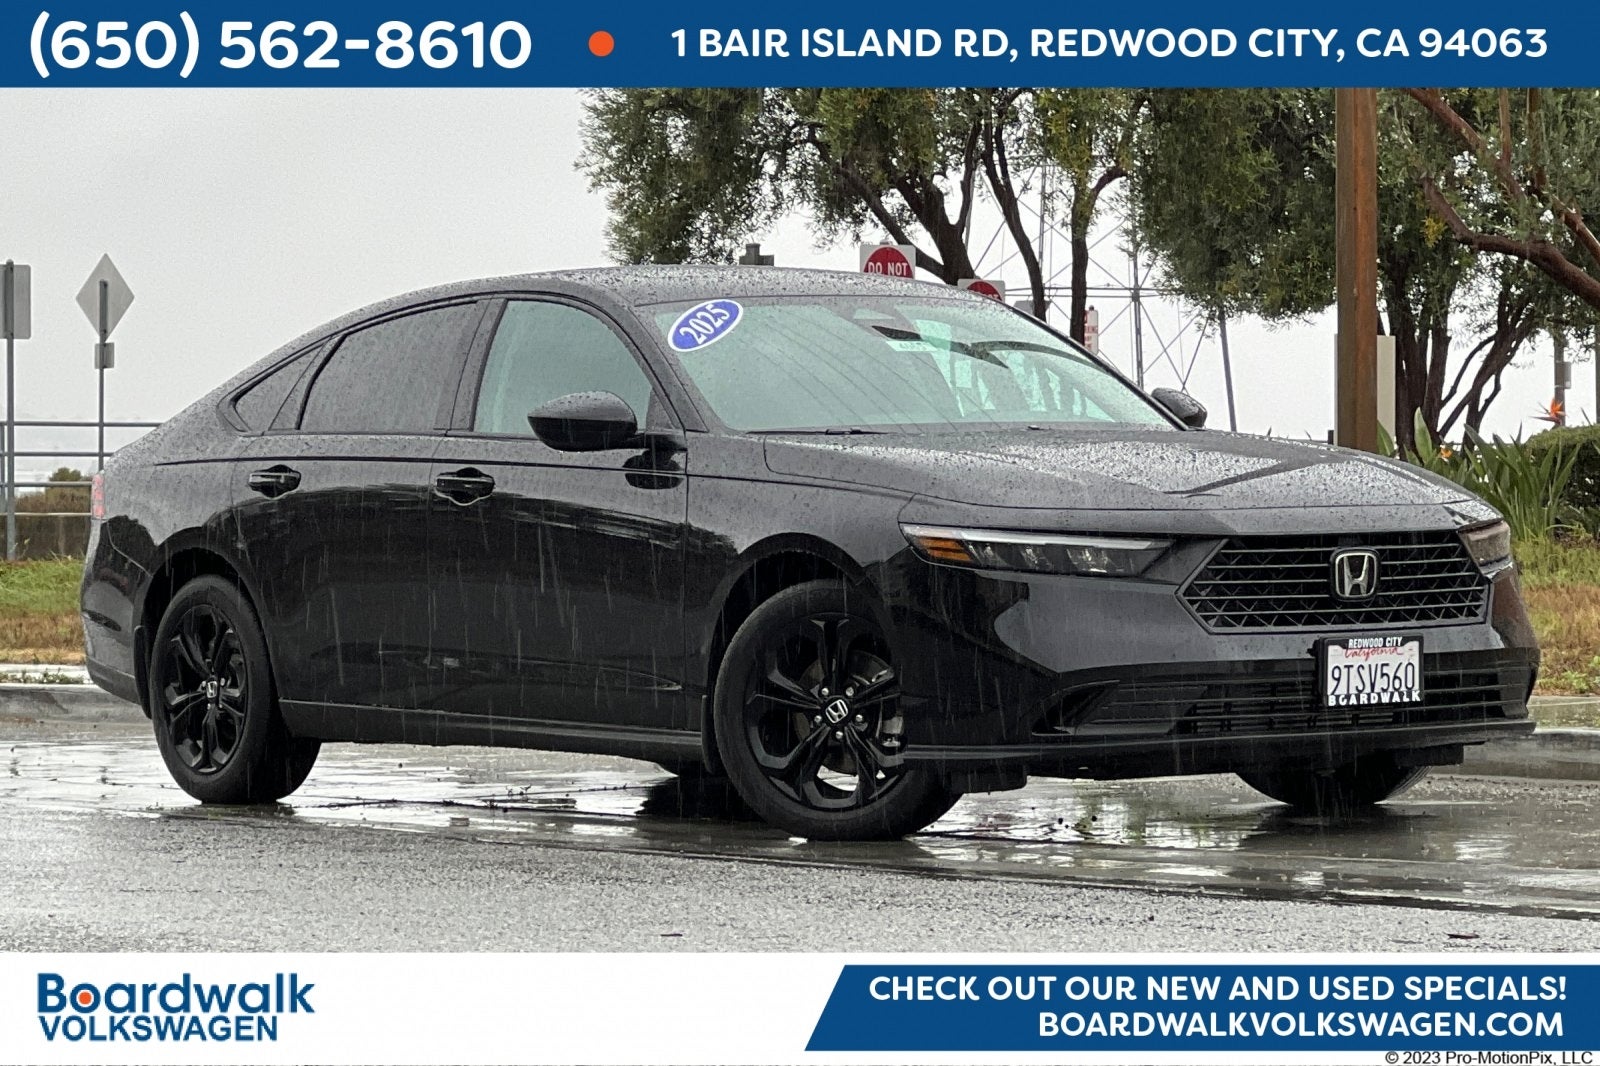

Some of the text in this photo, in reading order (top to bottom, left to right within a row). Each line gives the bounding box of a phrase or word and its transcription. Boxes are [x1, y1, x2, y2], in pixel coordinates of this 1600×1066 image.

[868, 262, 908, 276] DO NOT
[679, 303, 730, 344] 2025
[1348, 636, 1403, 649] REDWOOD CITY
[1345, 647, 1404, 661] California
[1331, 661, 1415, 695] 9TSV560
[1328, 691, 1421, 707] BOARDWALK
